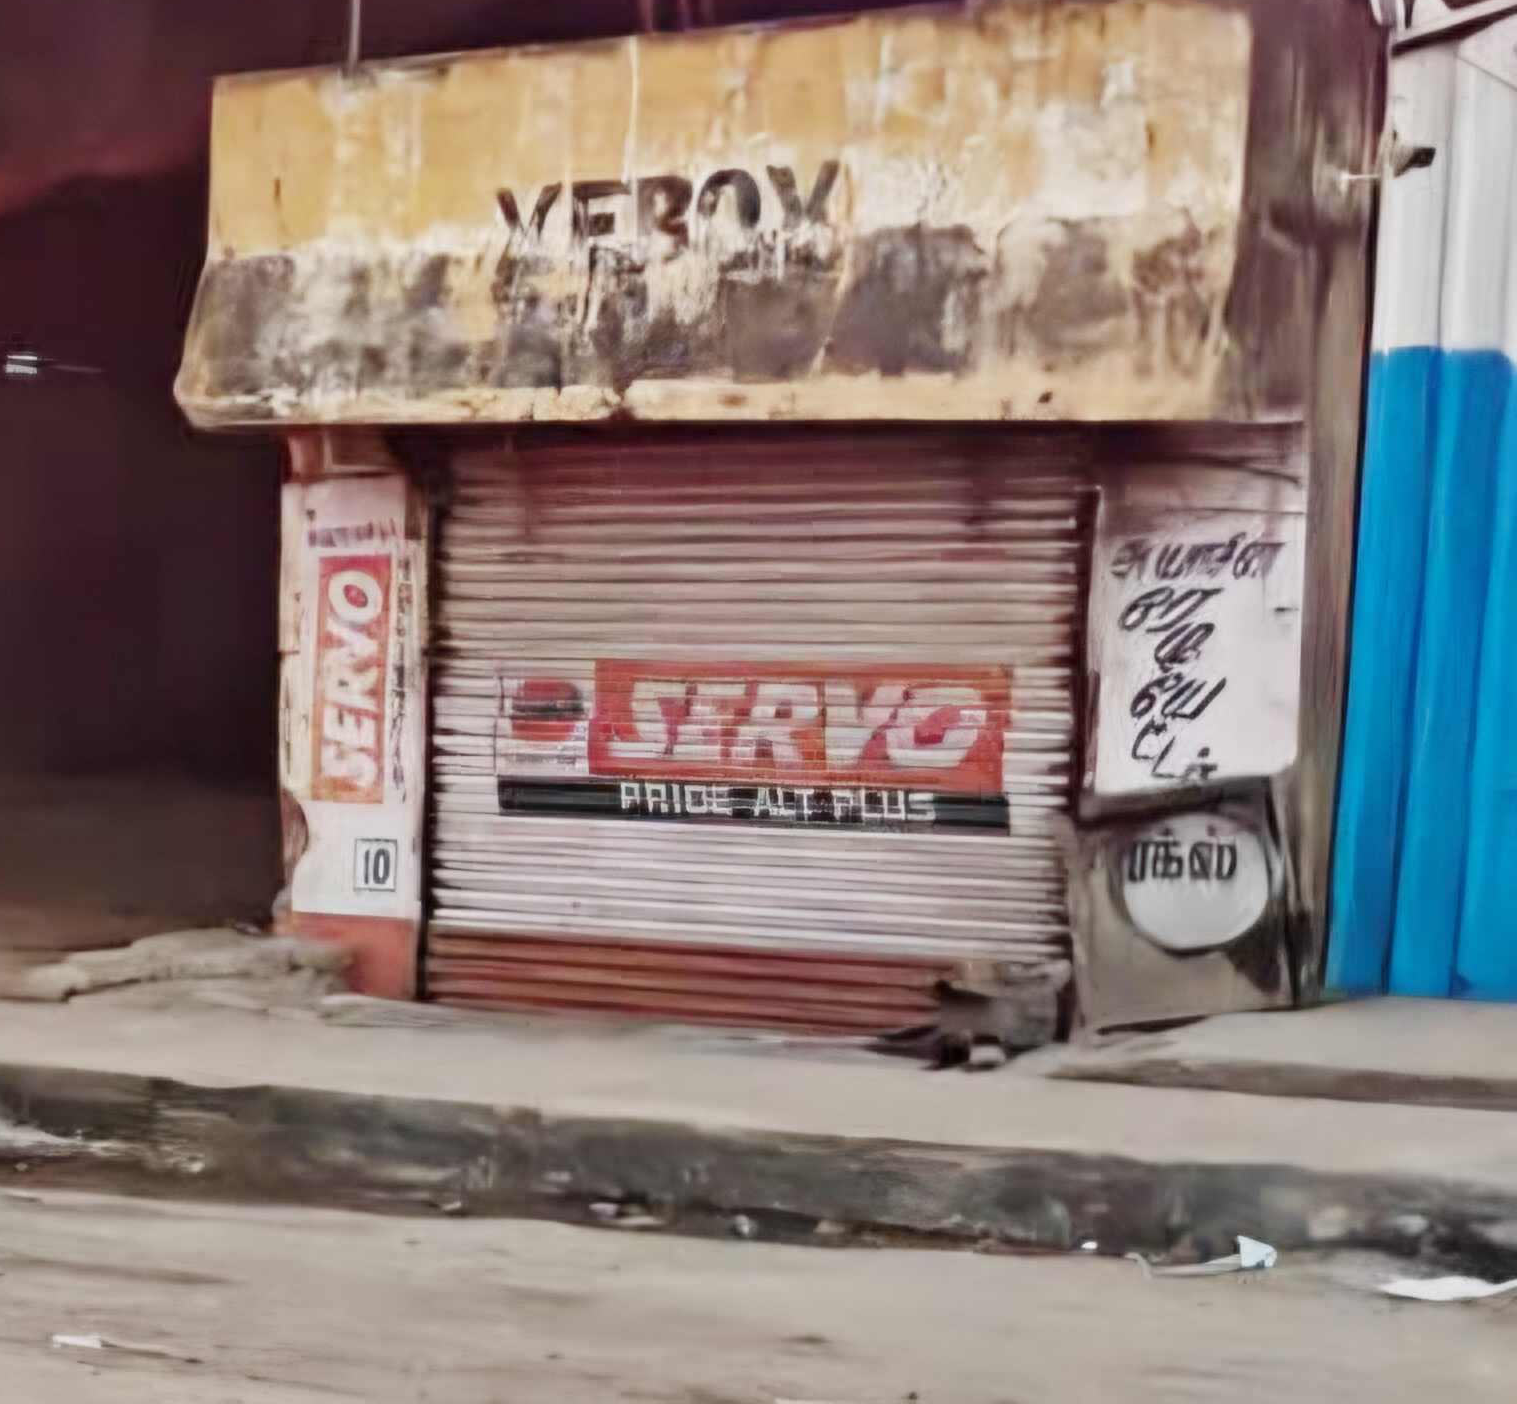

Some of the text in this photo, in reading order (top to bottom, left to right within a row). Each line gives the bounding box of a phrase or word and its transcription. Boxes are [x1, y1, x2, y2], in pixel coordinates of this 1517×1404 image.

[321, 570, 384, 789] SERVO
[605, 679, 989, 772] SERVO
[364, 847, 392, 886] 10
